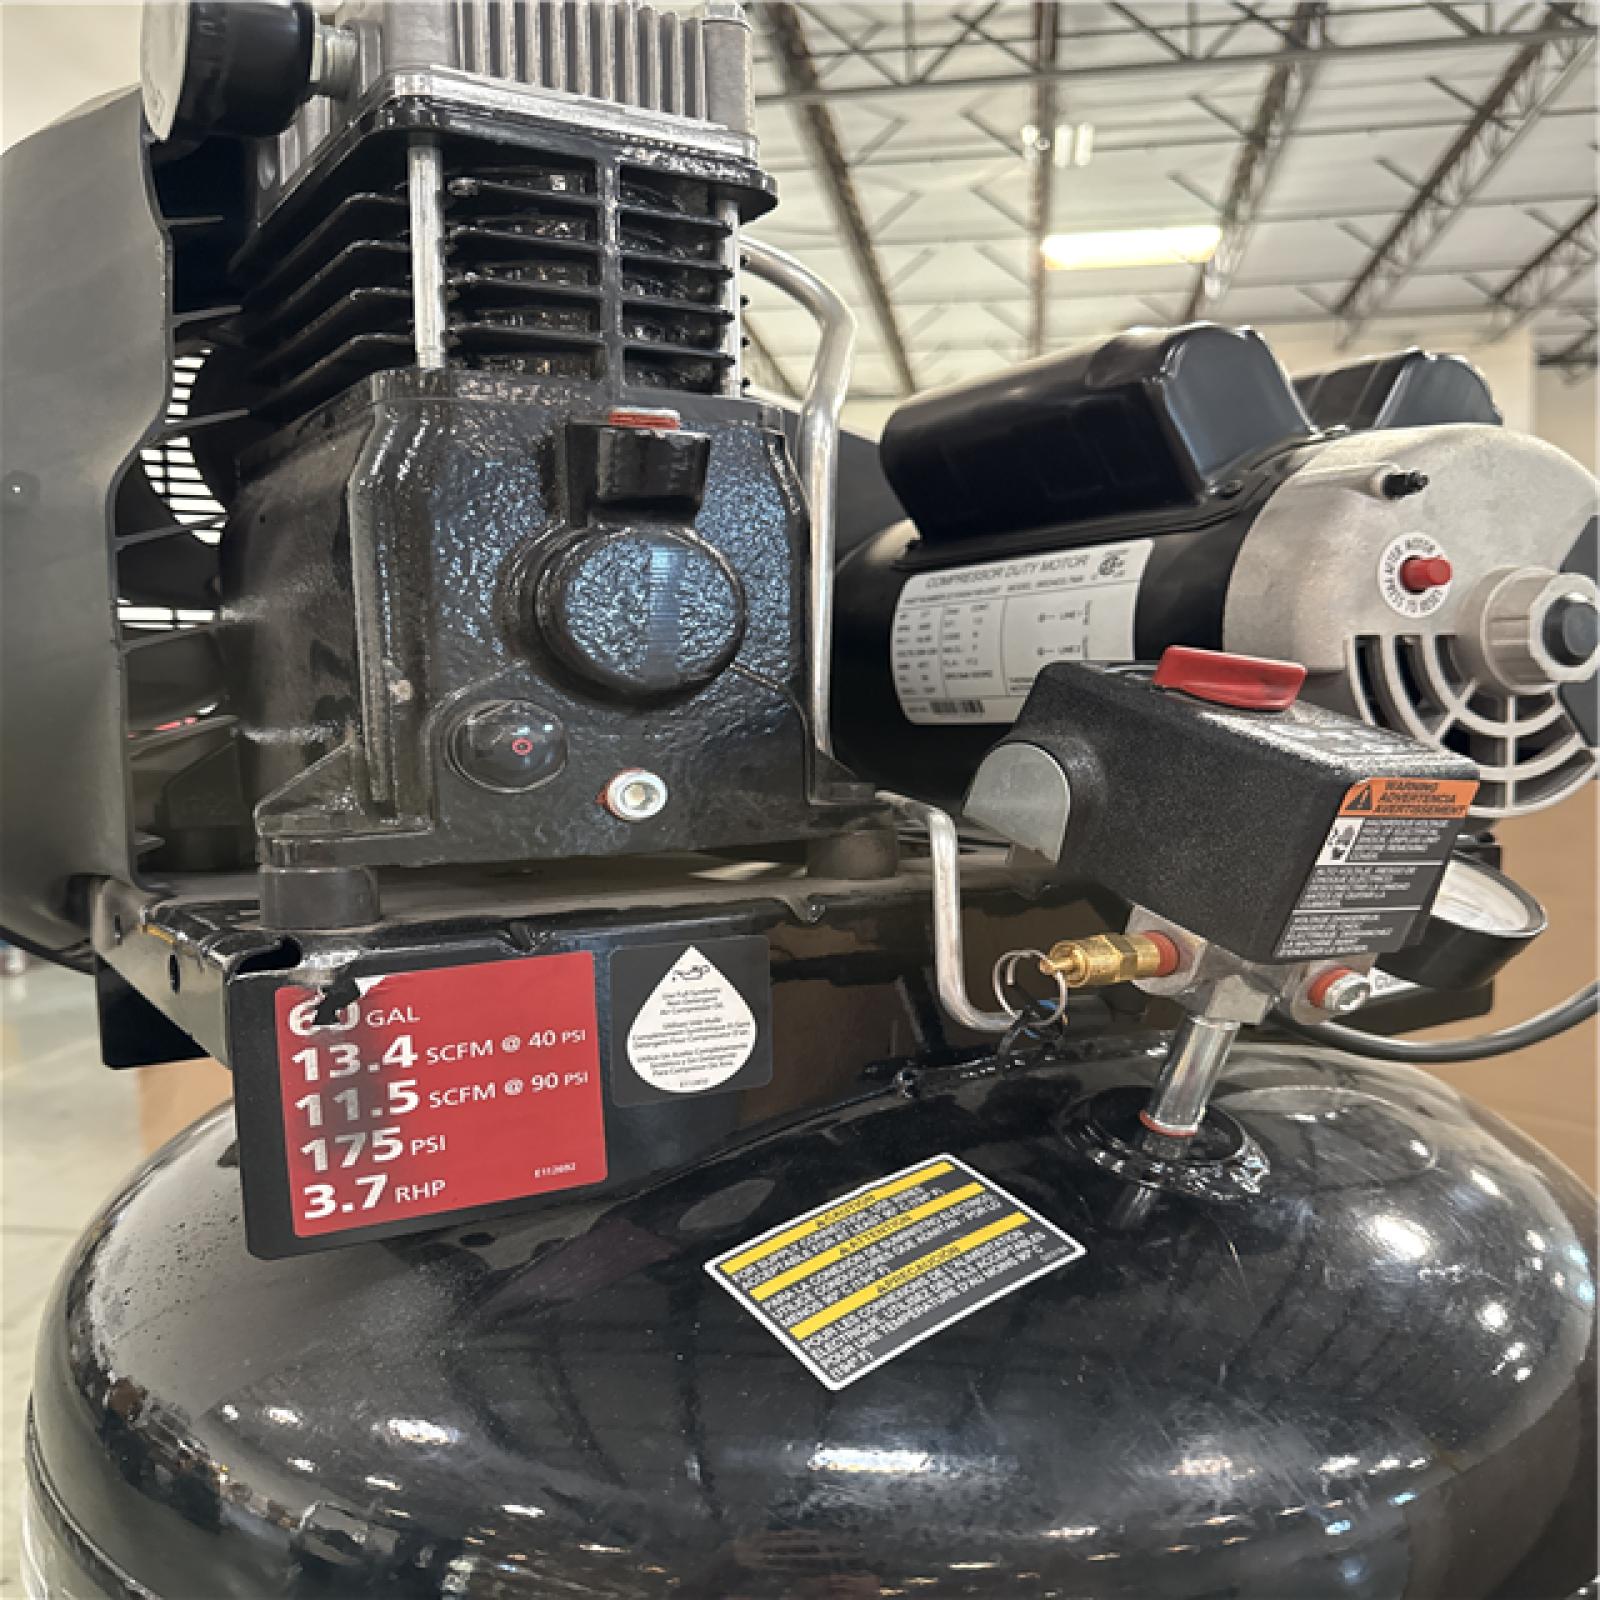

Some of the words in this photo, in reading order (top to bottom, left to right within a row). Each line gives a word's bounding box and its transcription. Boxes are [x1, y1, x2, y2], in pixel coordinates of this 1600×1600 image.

[925, 567, 1004, 588] COMPRESSOR
[1005, 563, 1038, 578] DUTY
[1040, 555, 1089, 571] MOTOR
[1378, 792, 1456, 802] ADVERTENCIA
[1385, 782, 1438, 791] WARNING
[366, 1006, 420, 1027] GAL
[292, 1034, 418, 1081] 13.4
[425, 1039, 494, 1065] SCFM
[501, 1034, 521, 1053] @
[528, 1029, 556, 1048] 40
[561, 1028, 586, 1043] PSI
[294, 1079, 420, 1127] 11.5
[429, 1081, 496, 1109] SCFM
[504, 1078, 524, 1096] @
[531, 1071, 559, 1092] 90
[564, 1071, 588, 1086] PSI
[300, 1126, 404, 1171] 175
[411, 1135, 447, 1156] PSI
[303, 1173, 389, 1220] 3.7
[395, 1179, 447, 1204] RHP
[820, 1194, 878, 1223] CAUTION
[846, 1214, 914, 1249] ATTENTION
